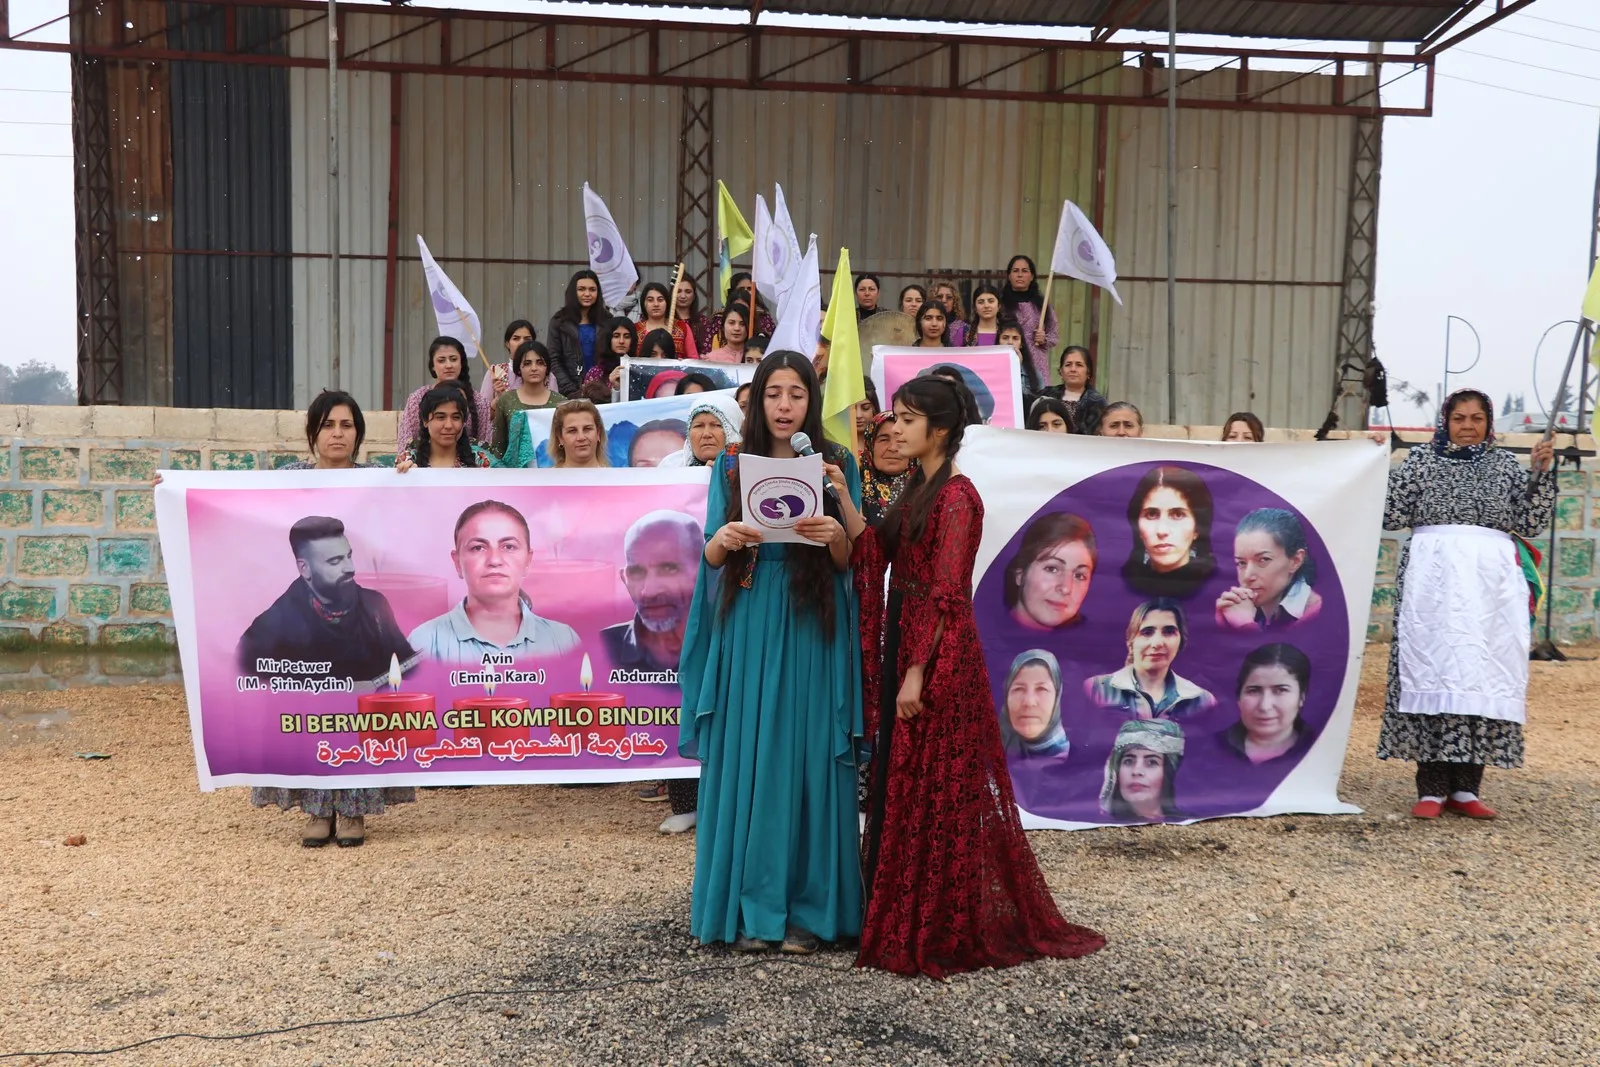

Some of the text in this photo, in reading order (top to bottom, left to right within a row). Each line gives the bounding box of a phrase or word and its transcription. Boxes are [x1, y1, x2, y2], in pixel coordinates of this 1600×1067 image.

[257, 659, 331, 673] Mir Petwer
[481, 653, 514, 665] Avin
[609, 669, 680, 683] Abdurrah
[271, 678, 301, 693] Şirin
[281, 714, 302, 733] BI
[306, 711, 438, 733] BERWDANA
[443, 709, 486, 729] GEL
[490, 707, 594, 727] KOMPILO
[316, 732, 667, 768] مقاومة الشعوب تنهي المؤامرة
